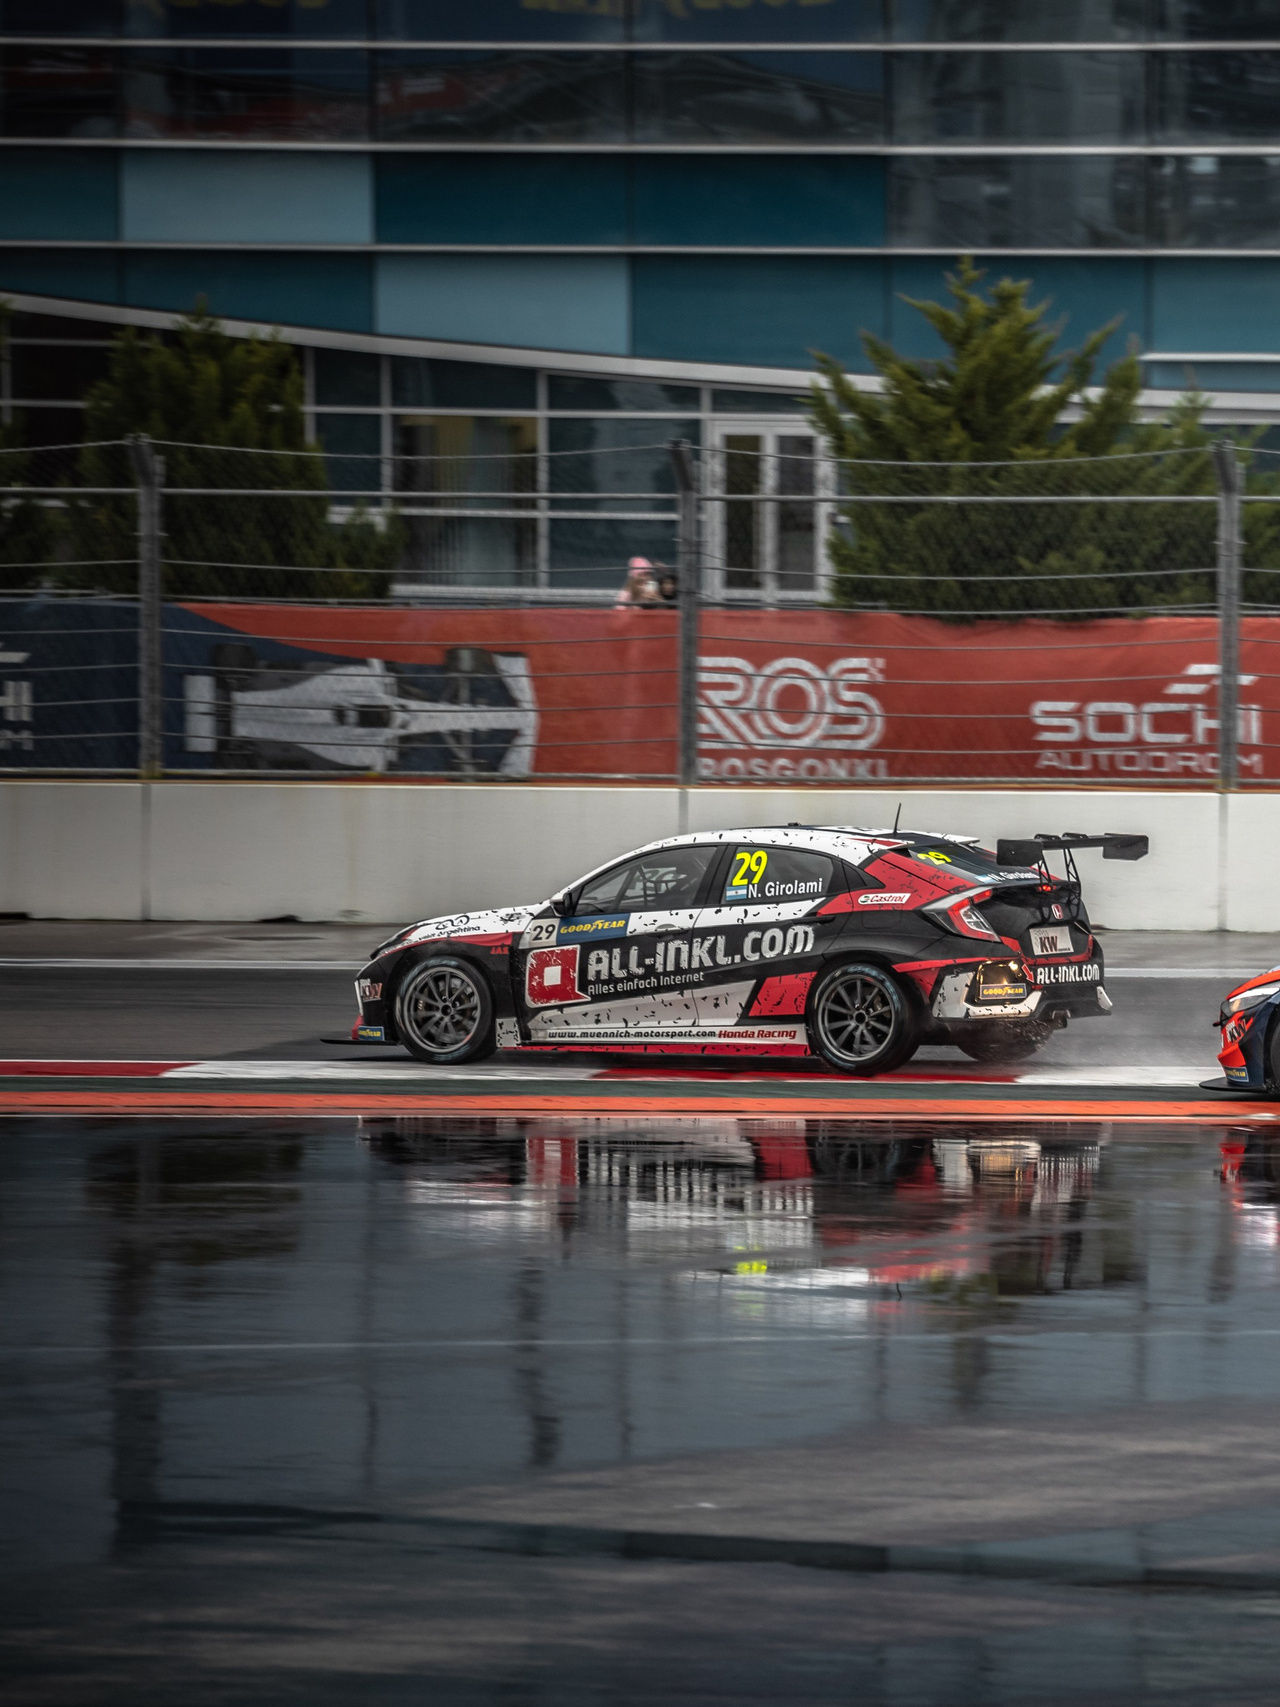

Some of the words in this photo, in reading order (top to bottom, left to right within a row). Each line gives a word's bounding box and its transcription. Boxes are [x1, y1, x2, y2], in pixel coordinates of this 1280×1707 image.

[695, 656, 887, 749] ROS
[1030, 701, 1262, 744] SOCHI
[917, 851, 952, 865] 29
[732, 850, 768, 886] 29
[748, 883, 762, 898] N.
[765, 877, 823, 897] Girolami
[870, 895, 906, 903] Castrol
[532, 924, 556, 941] 29
[560, 920, 626, 934] GOODYEAR
[1039, 936, 1058, 953] KW
[587, 984, 614, 995] Alles
[617, 977, 657, 993] einfach
[660, 972, 704, 985] Internet
[548, 1029, 716, 1039] www.muennich-motorsport.com
[718, 1029, 755, 1039] Honda
[757, 1029, 797, 1040] Racing
